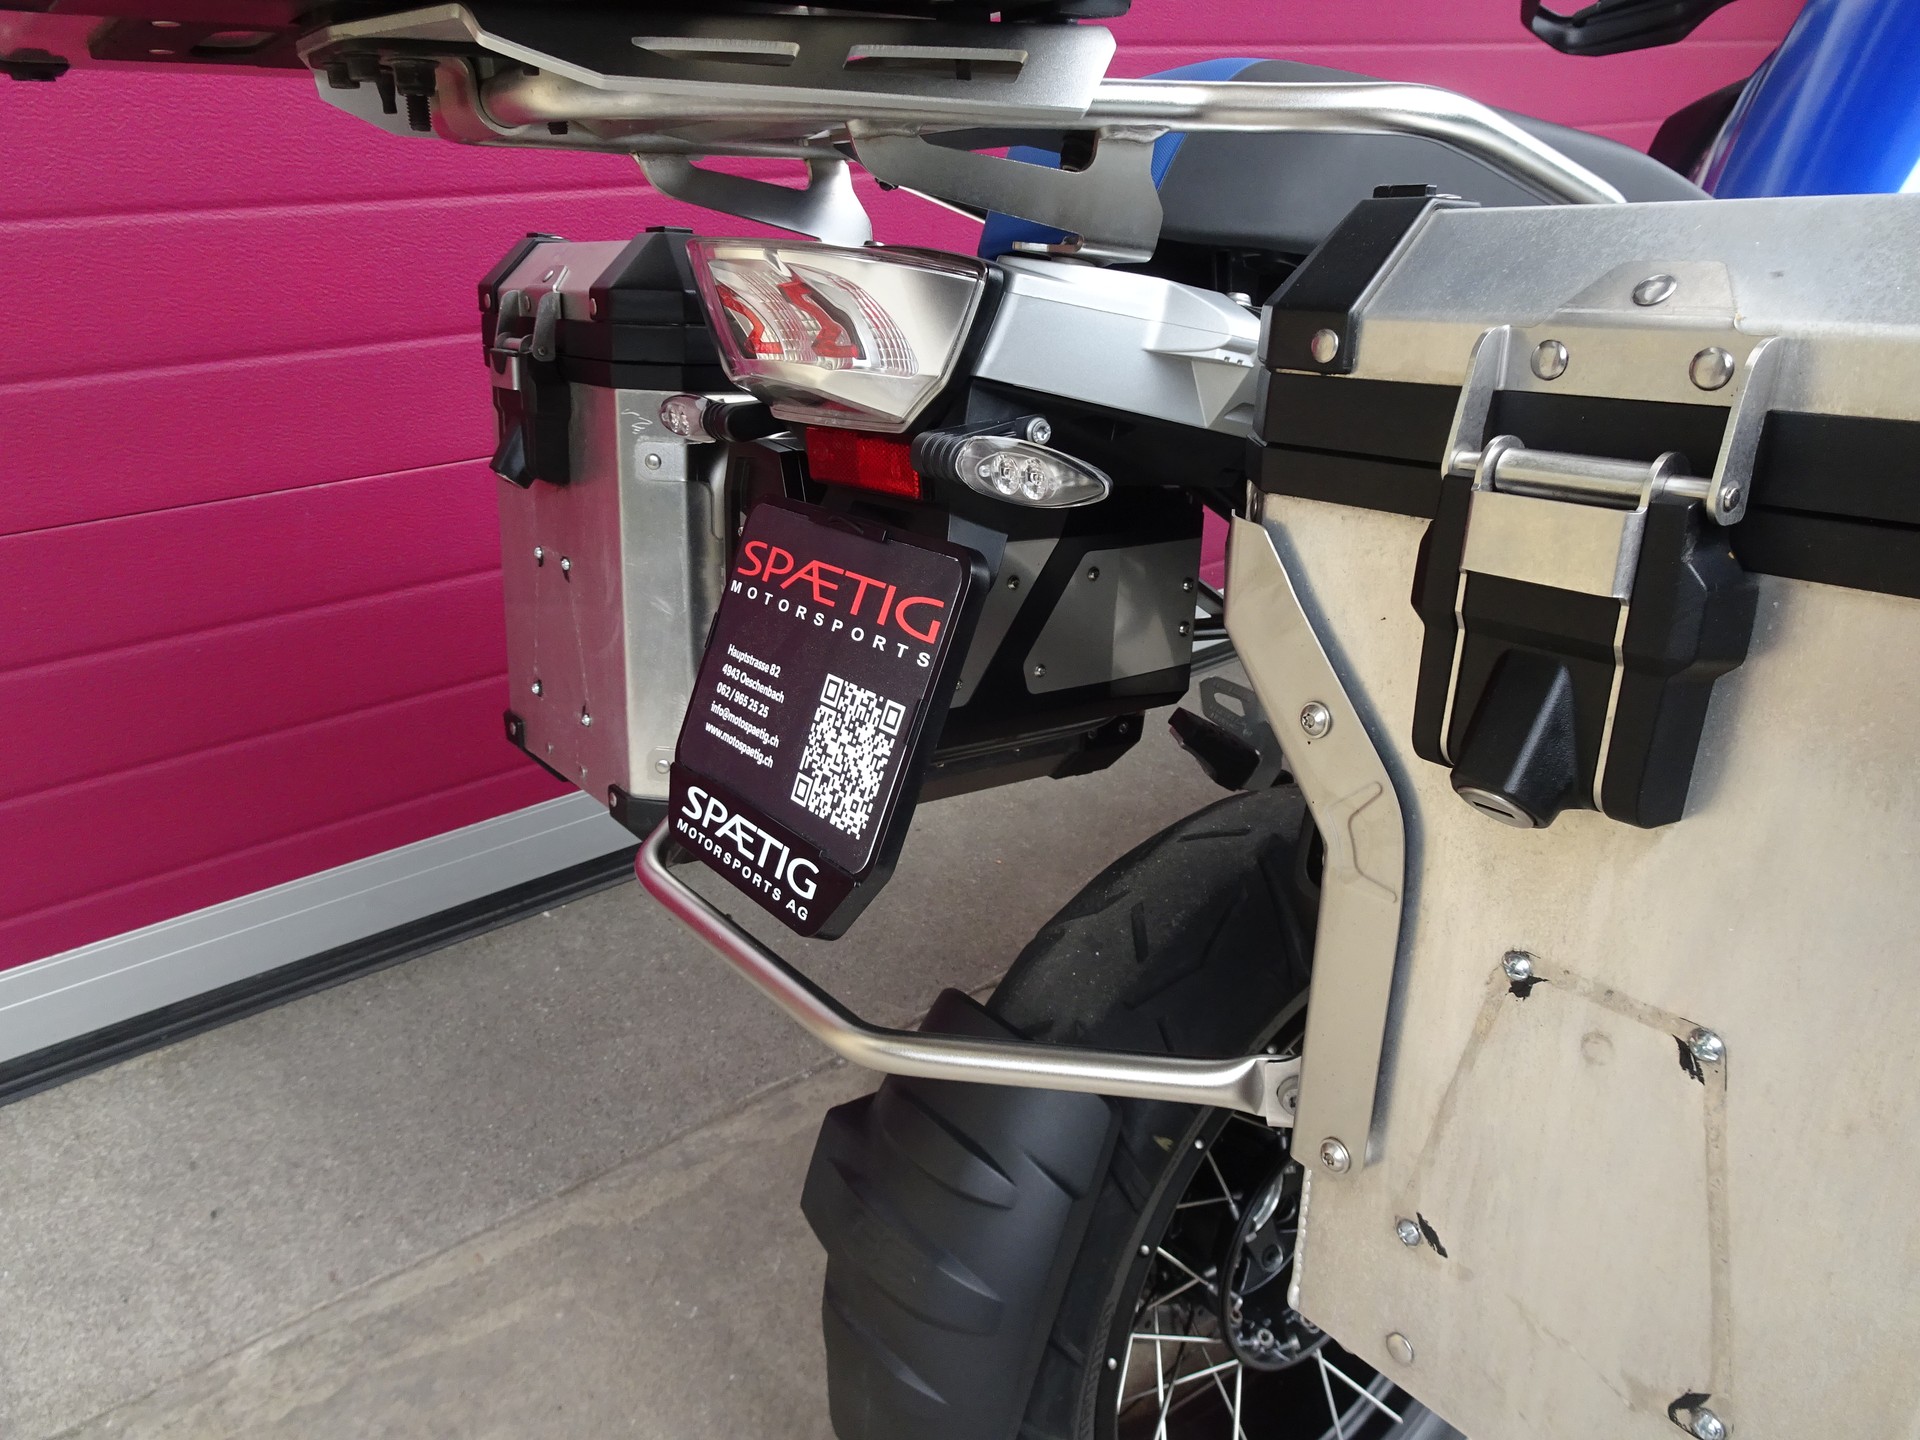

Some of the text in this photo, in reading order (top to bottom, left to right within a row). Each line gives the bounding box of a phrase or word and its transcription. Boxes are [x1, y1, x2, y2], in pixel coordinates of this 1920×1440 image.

[737, 540, 945, 645] SPÆTIG
[730, 579, 931, 668] MOTORSPORTS
[722, 663, 785, 704] 4943 Oeschenbach
[727, 643, 781, 678] Hauptstrasse 82
[716, 681, 731, 697] 062
[733, 690, 749, 708] 965
[747, 698, 759, 713] 25
[757, 703, 770, 718] 25
[705, 722, 774, 768] www.motospaetig.ch
[710, 700, 780, 748] info@motospaetig.ch
[681, 785, 820, 900] SPÆTIG
[676, 818, 809, 921] MOTORSPORTS AG
